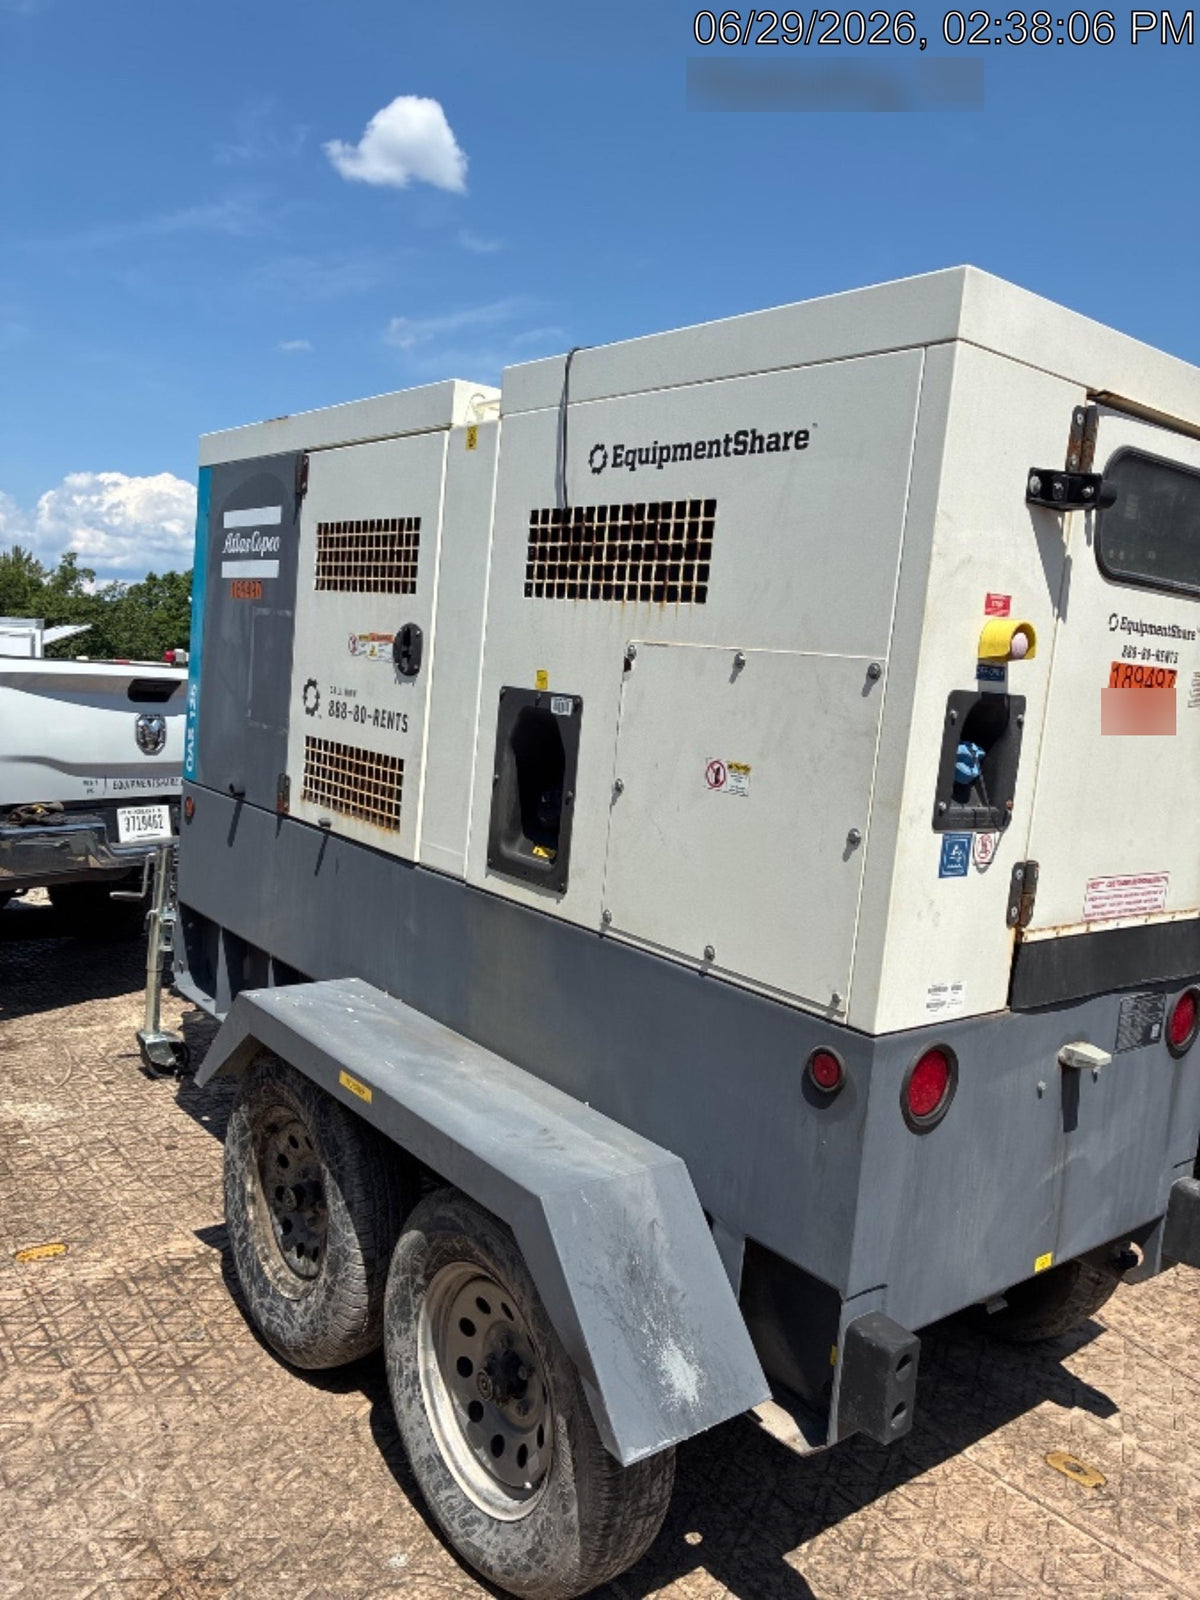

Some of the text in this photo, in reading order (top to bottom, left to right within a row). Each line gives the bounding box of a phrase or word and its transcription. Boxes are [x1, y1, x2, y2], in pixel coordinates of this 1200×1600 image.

[611, 428, 810, 472] EquipmentShare
[1120, 616, 1196, 641] EquipmentShare
[328, 699, 409, 733] 888-80-RENTS
